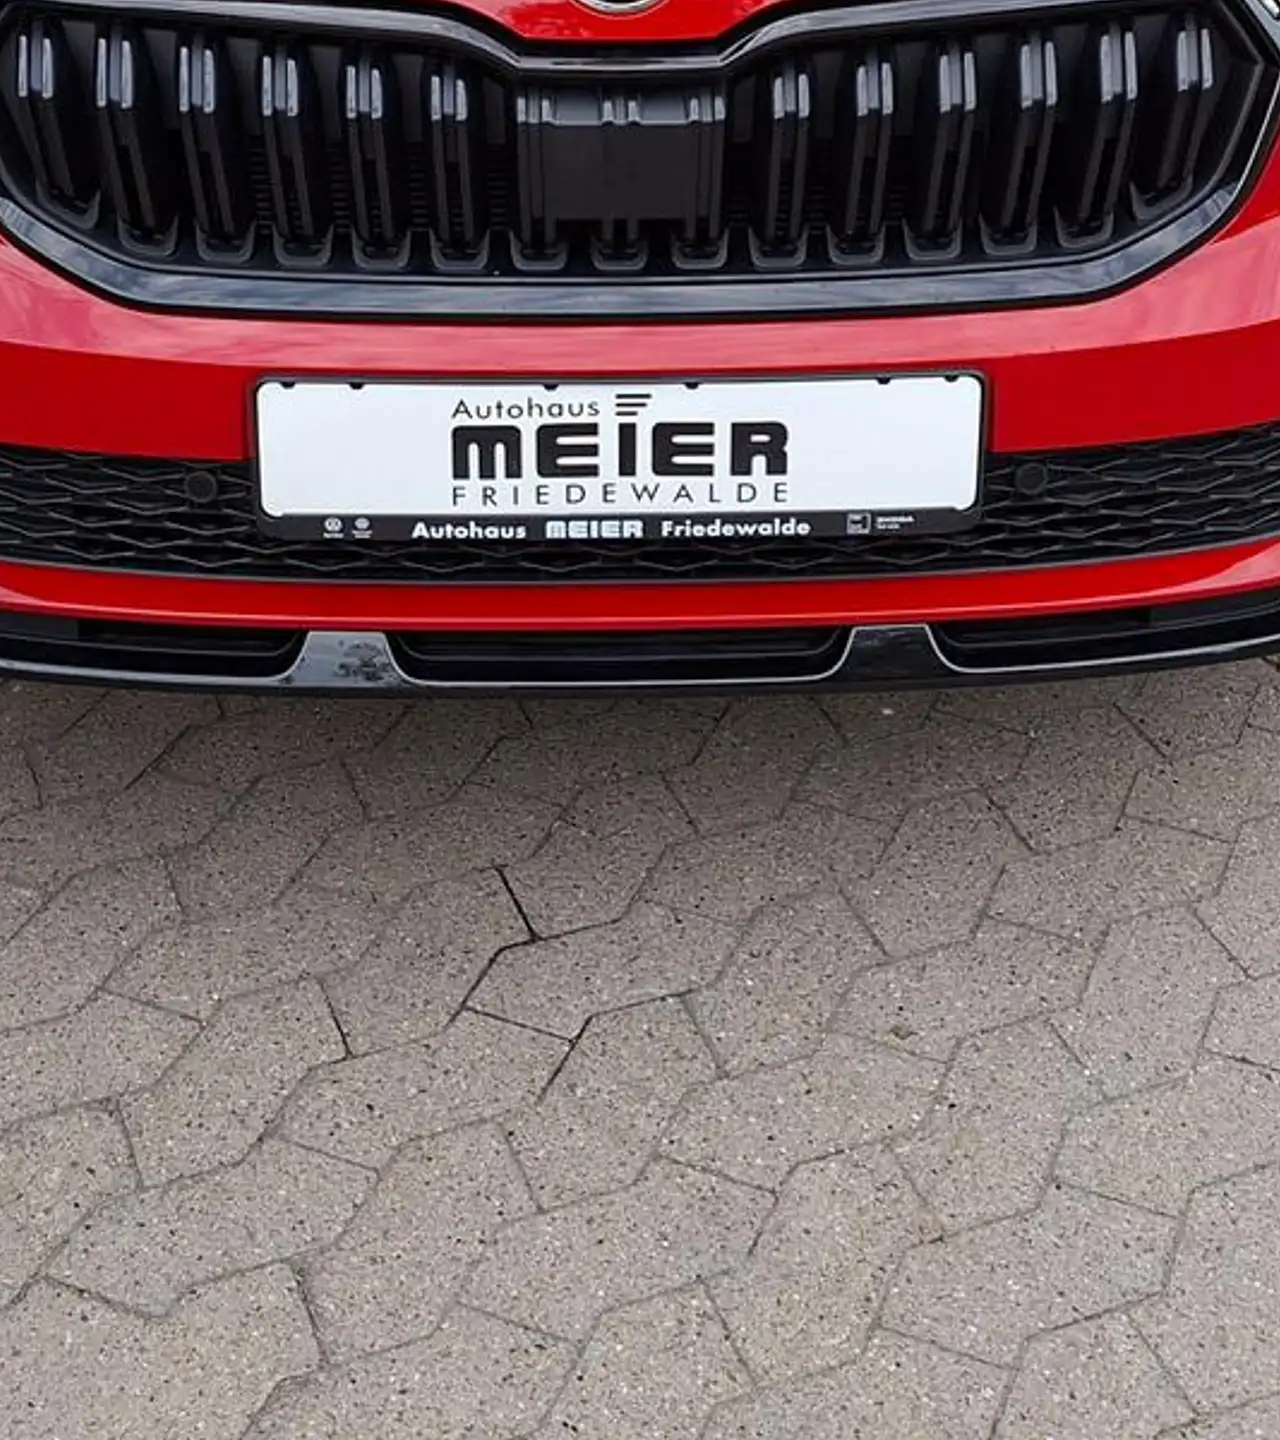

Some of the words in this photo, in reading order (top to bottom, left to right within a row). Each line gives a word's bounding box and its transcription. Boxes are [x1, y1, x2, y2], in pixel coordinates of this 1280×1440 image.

[451, 397, 601, 420] Autohaus
[451, 421, 789, 480] MEIER
[452, 481, 788, 507] FRIEDEWALDE
[412, 521, 526, 540] Autohaus
[545, 519, 645, 540] MEIER
[661, 518, 812, 539] Friedewalde
